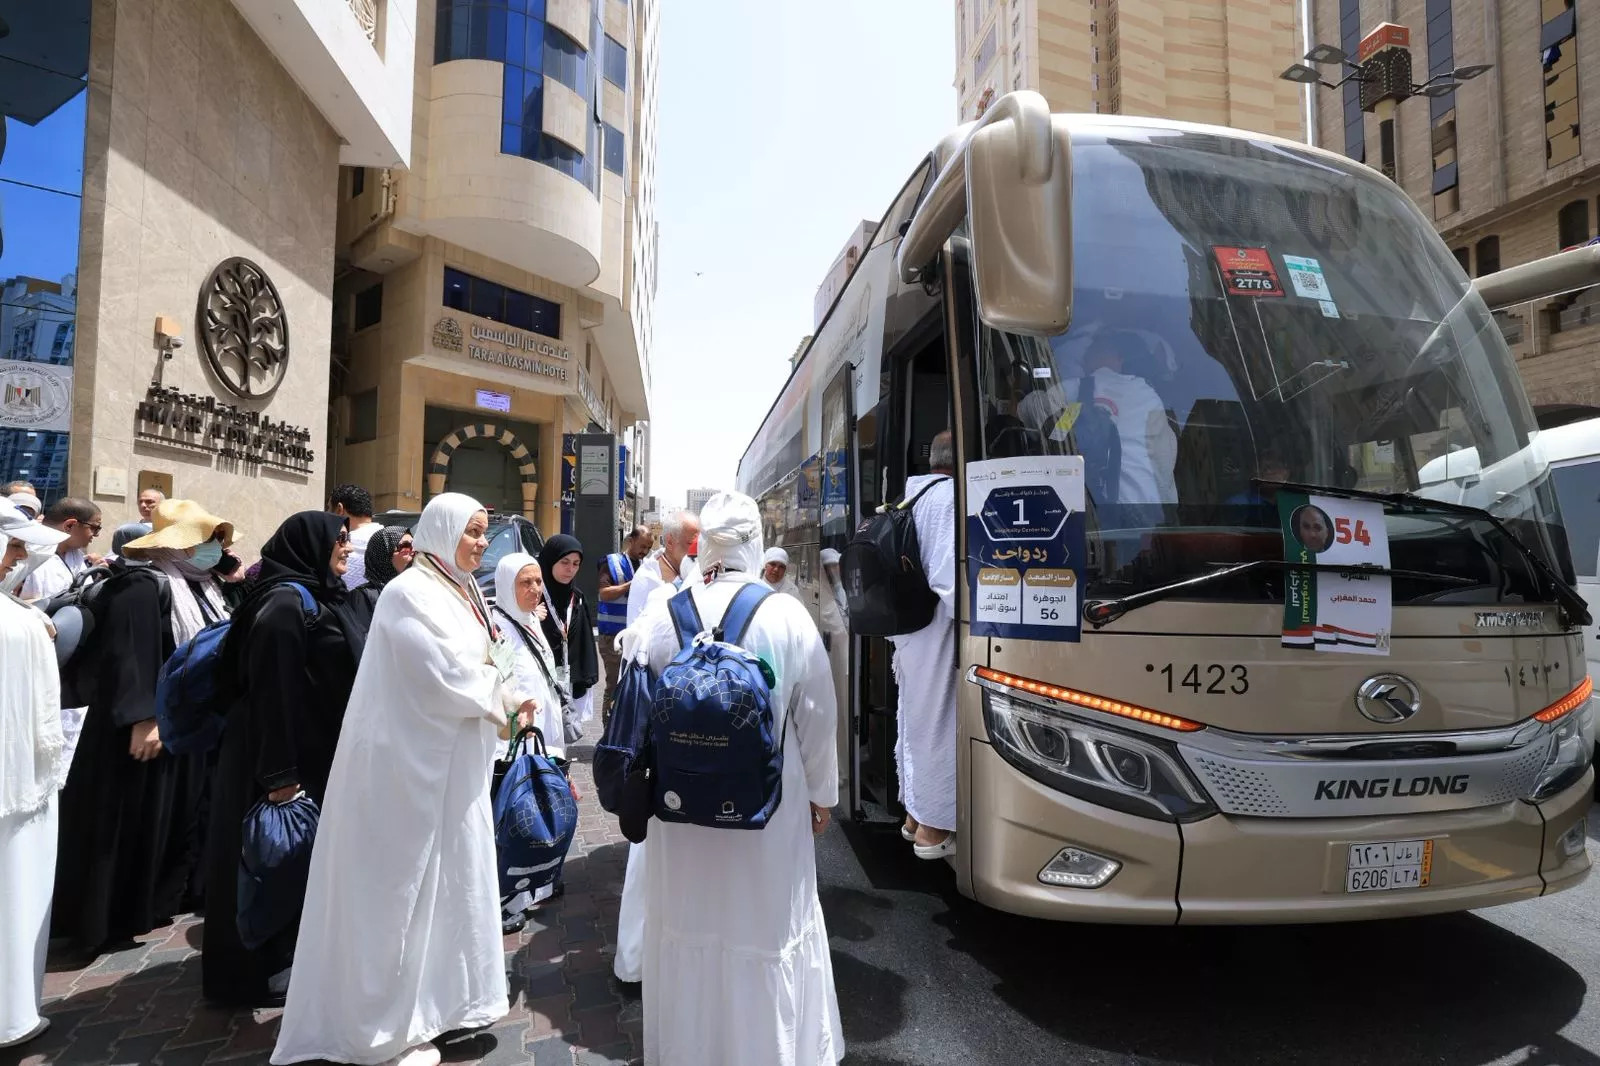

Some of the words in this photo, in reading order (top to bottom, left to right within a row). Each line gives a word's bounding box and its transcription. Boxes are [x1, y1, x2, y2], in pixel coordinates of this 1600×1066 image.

[1235, 278, 1272, 289] 2776
[468, 345, 496, 362] TARA
[497, 353, 541, 374] ALYASMIN
[543, 364, 569, 380] HOTEL
[1013, 499, 1030, 525] 1
[1335, 518, 1371, 546] 54
[1033, 594, 1066, 605] الجوهرة
[1359, 596, 1377, 604] محمد
[1040, 608, 1059, 620] 56
[1314, 778, 1390, 800] KING
[1392, 774, 1470, 797] LONG
[1355, 846, 1389, 866] ٦٢٠٦
[1352, 869, 1388, 890] 6206
